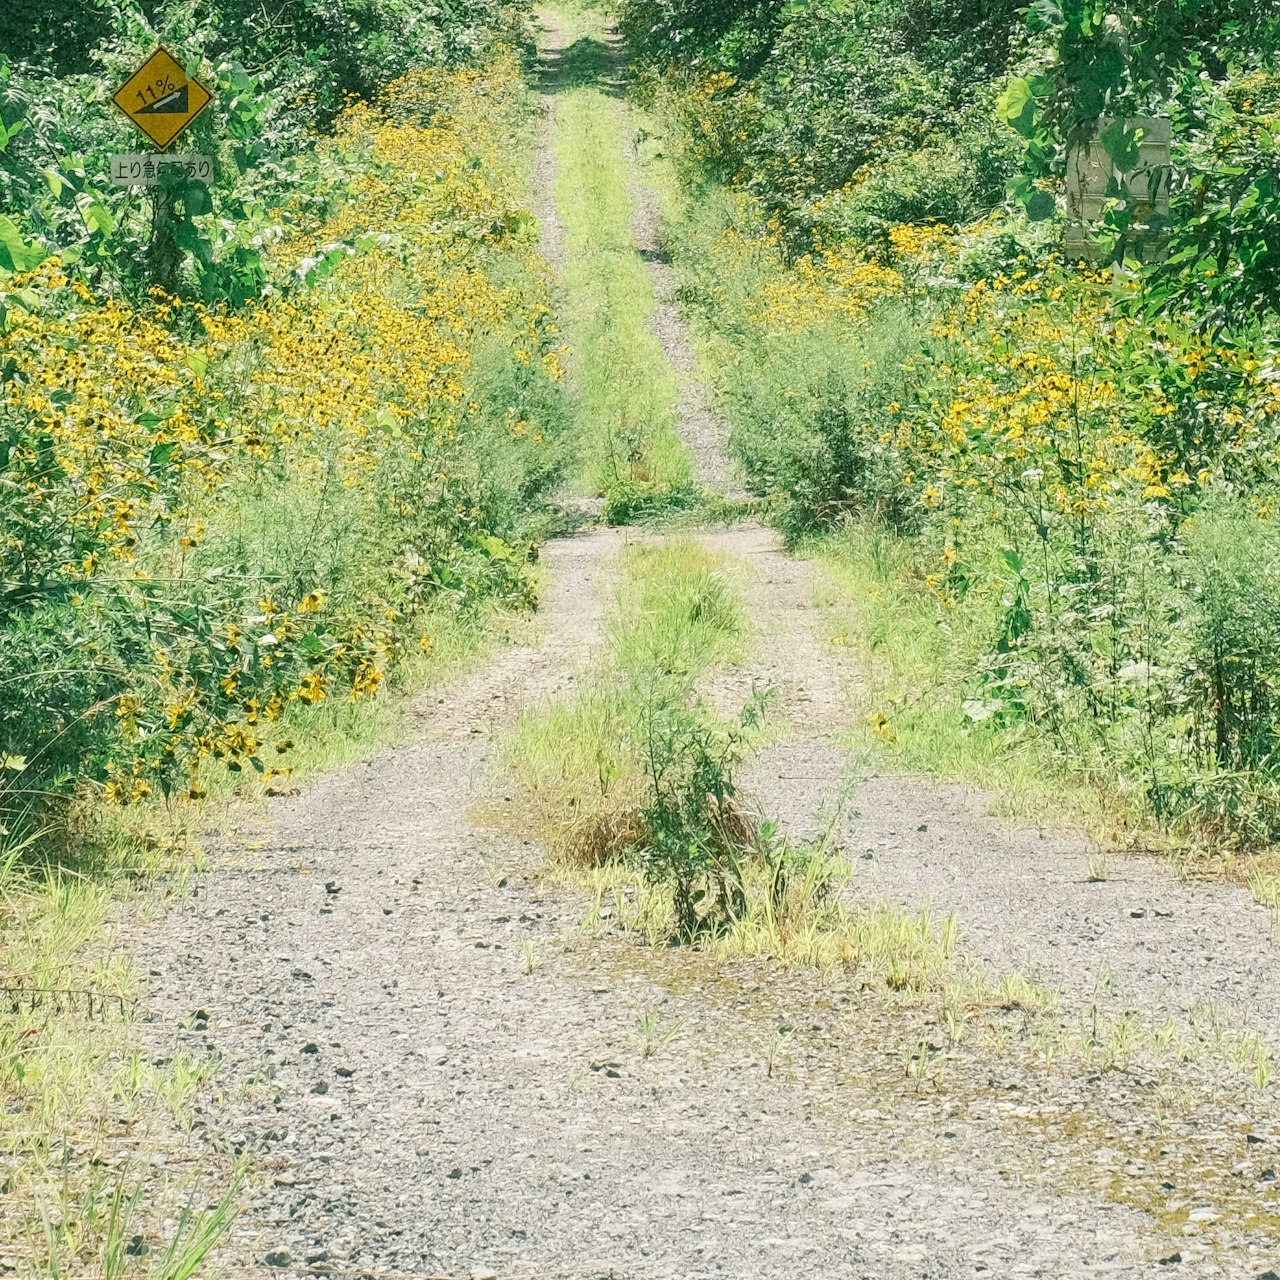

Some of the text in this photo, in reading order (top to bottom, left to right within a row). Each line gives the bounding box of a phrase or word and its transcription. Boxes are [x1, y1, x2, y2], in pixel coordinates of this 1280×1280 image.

[135, 75, 175, 105] 11%
[115, 161, 210, 179] 上り急あり
